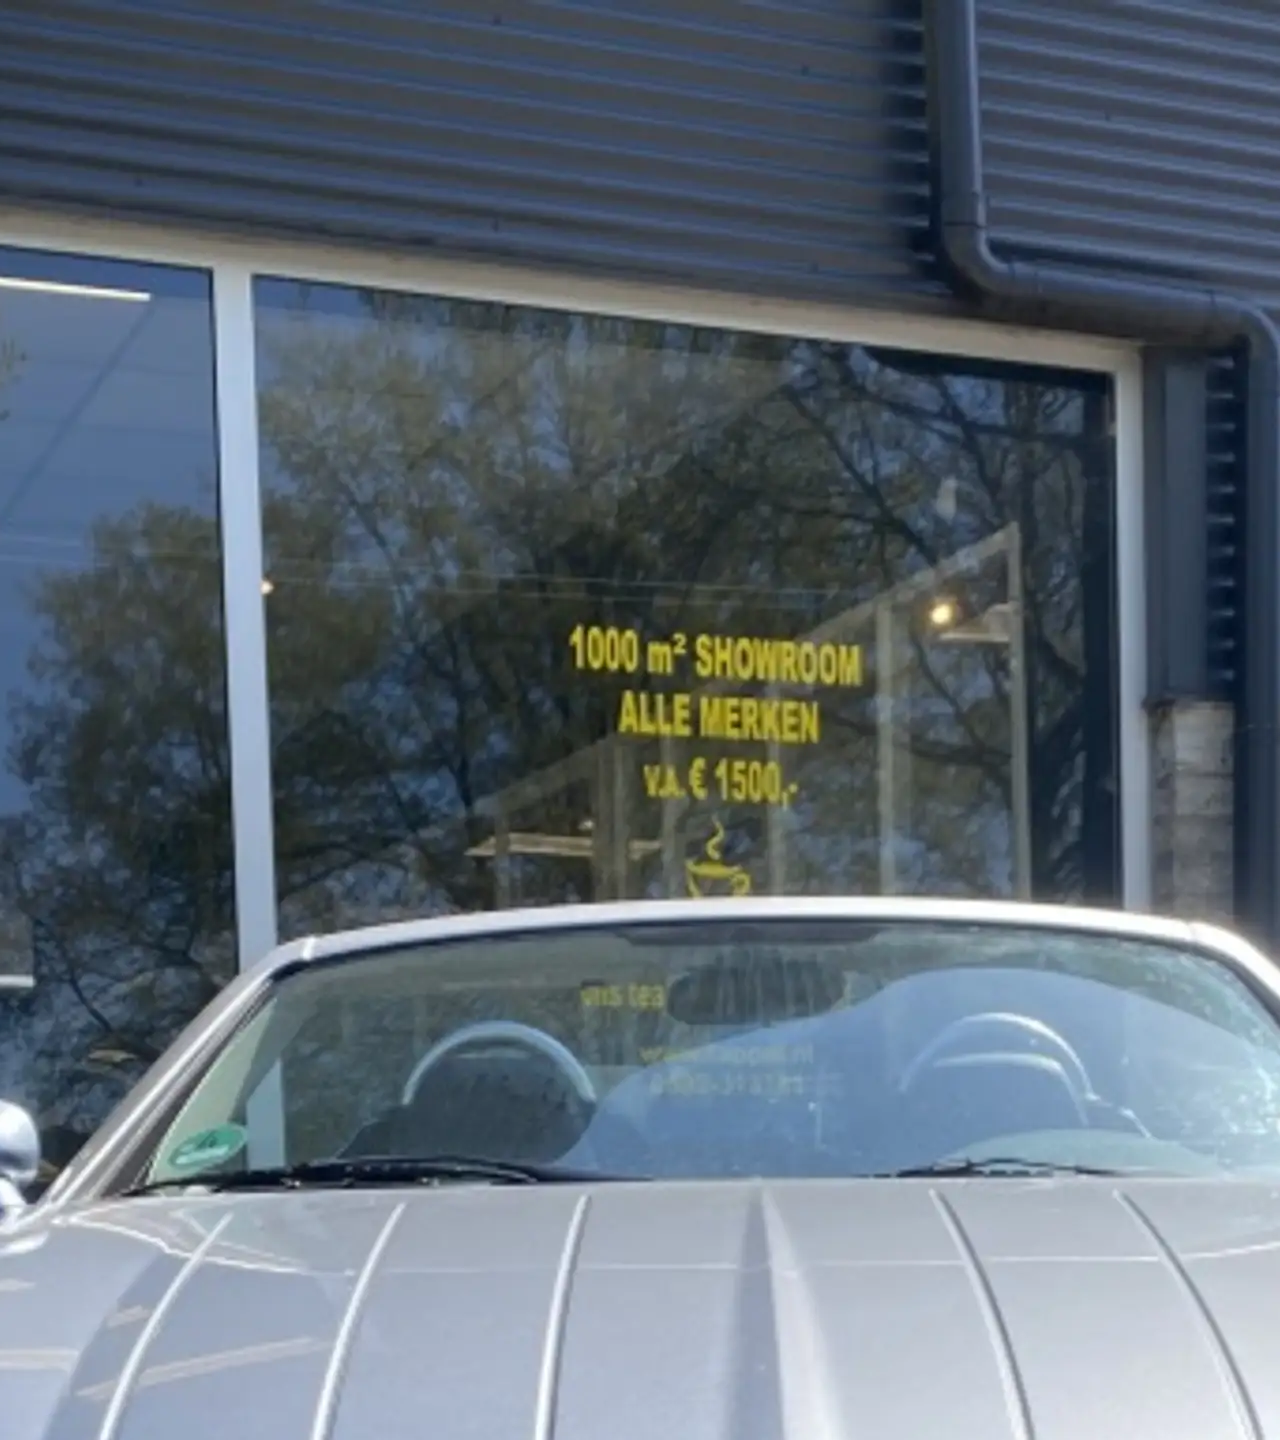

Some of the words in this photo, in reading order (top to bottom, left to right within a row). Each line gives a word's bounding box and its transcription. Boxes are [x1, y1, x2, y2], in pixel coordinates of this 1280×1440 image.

[570, 624, 639, 672] 1000
[646, 633, 686, 676] m²
[696, 633, 862, 686] SHOWROOM
[618, 690, 691, 737] ALLE
[700, 696, 818, 744] MERKEN
